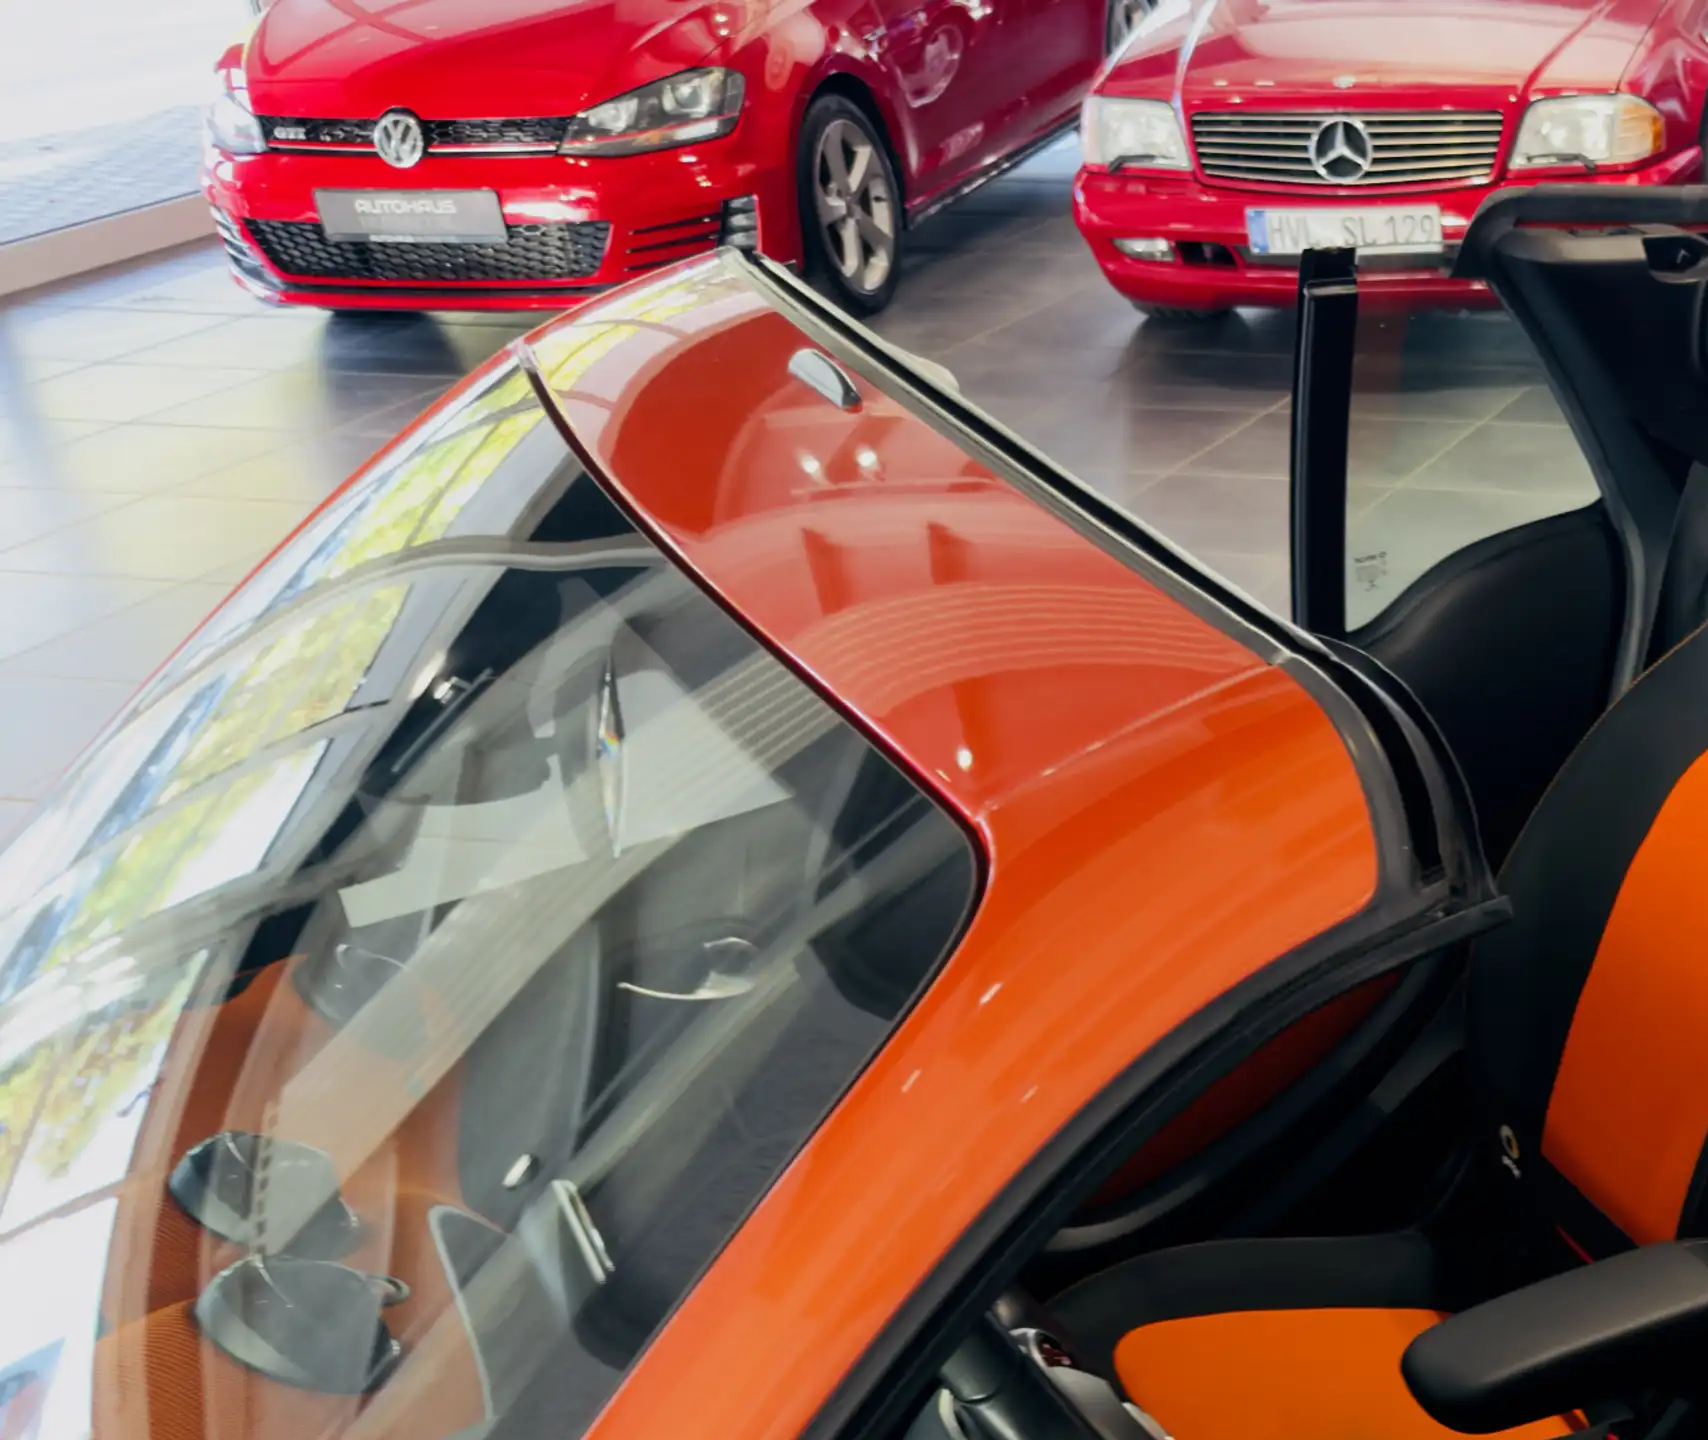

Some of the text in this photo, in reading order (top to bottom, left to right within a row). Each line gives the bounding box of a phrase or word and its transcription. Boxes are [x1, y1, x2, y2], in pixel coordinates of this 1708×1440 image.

[354, 199, 457, 214] AUTOHAUS
[1270, 214, 1434, 249] HVL SL 129
